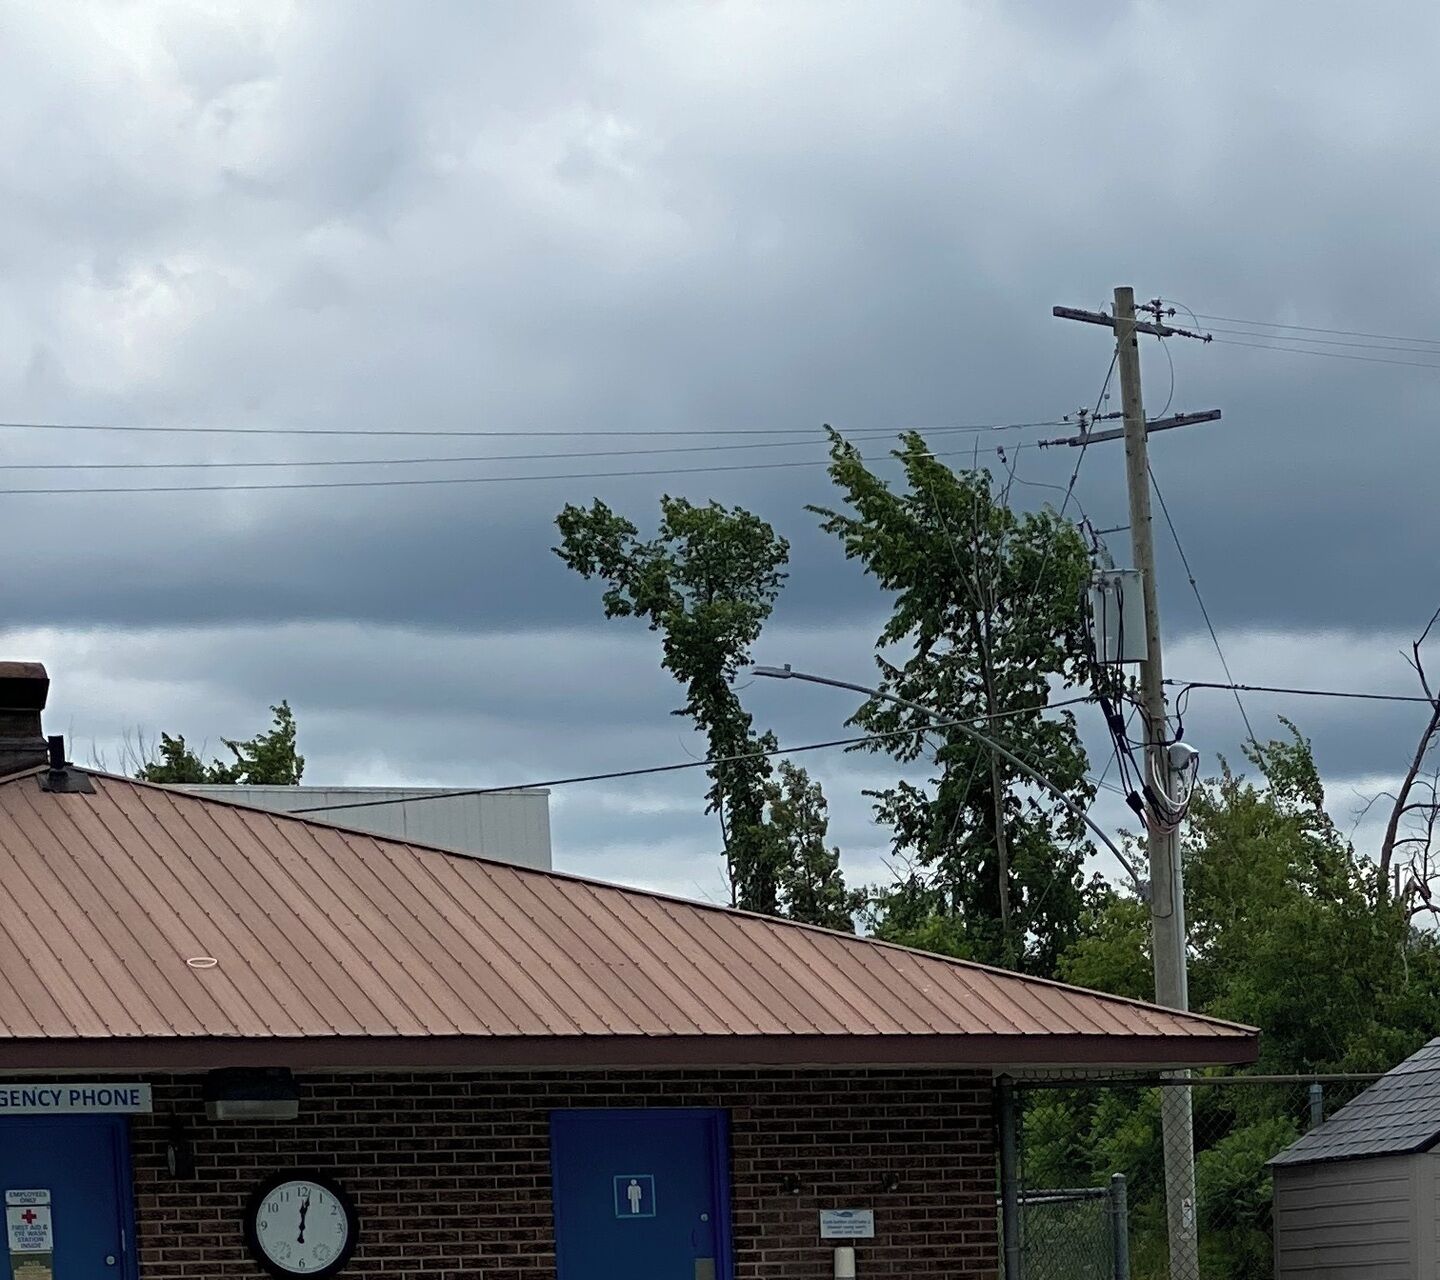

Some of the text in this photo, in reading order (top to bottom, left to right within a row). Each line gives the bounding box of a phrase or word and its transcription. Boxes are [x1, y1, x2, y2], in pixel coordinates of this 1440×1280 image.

[69, 1089, 140, 1106] PHONE
[280, 1191, 289, 1202] 11
[297, 1186, 308, 1197] 12
[267, 1203, 279, 1213] 10
[260, 1221, 268, 1231] 9
[298, 1258, 306, 1268] 6
